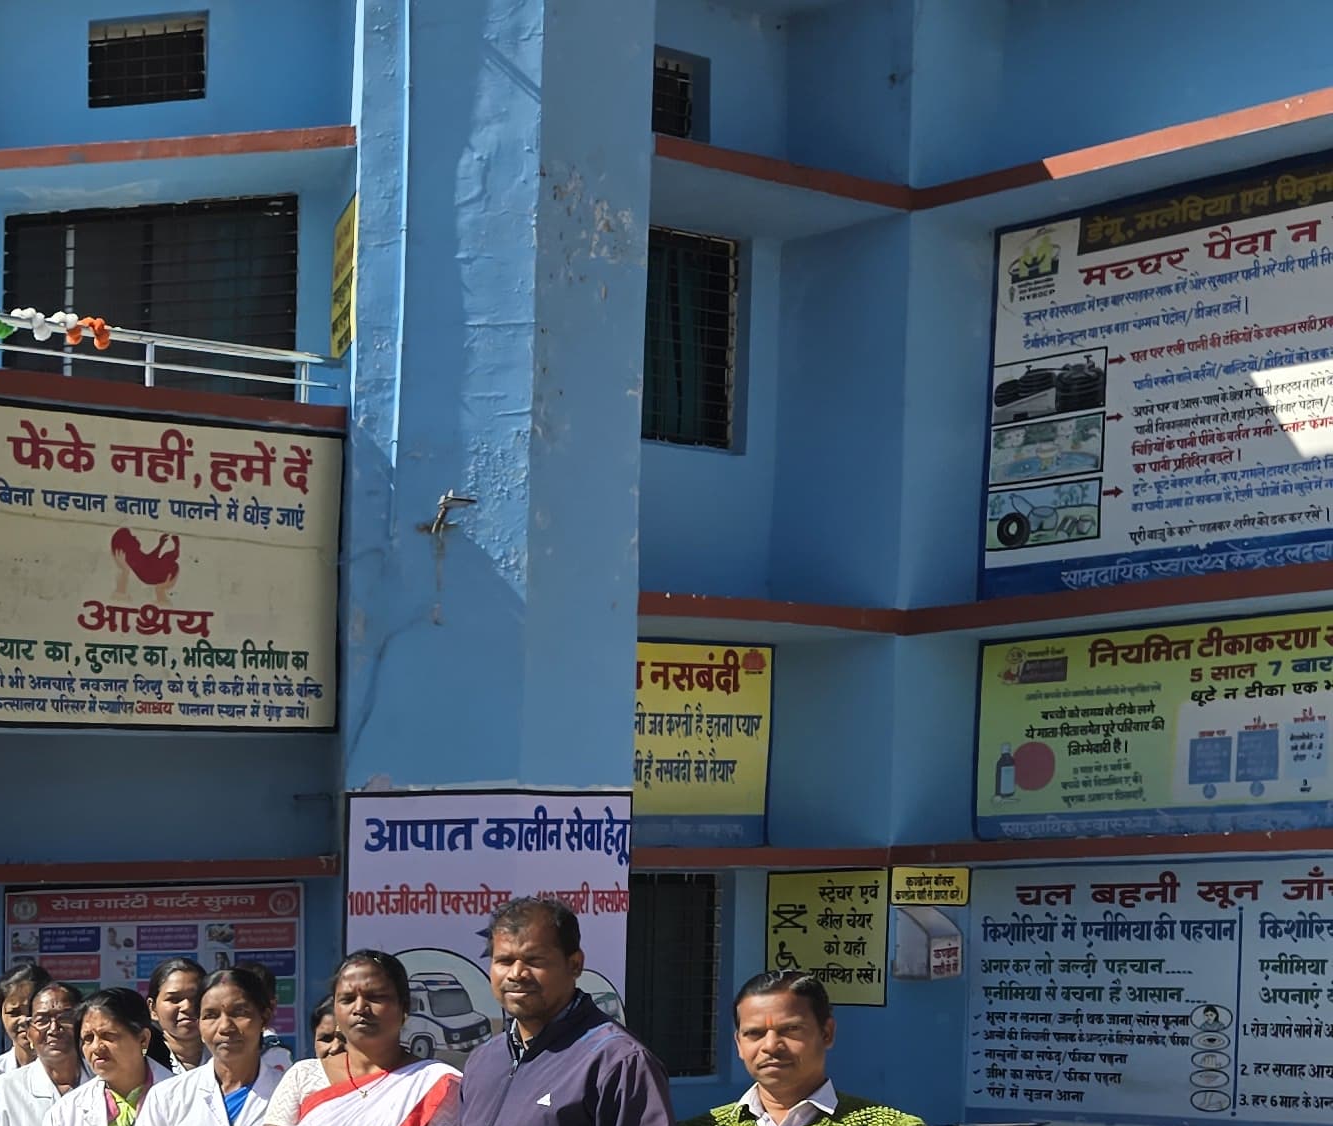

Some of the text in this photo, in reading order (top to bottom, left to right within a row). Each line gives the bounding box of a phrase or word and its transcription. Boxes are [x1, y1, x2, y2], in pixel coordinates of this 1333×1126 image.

[1203, 226, 1278, 260] पैदा
[1286, 220, 1321, 243] न
[7, 419, 96, 473] फेंके
[210, 441, 276, 492] हमें
[283, 445, 313, 495] दें
[41, 489, 107, 513] पहचान
[114, 493, 159, 519] बताए
[169, 494, 221, 522] पालने
[226, 496, 239, 523] में
[77, 600, 214, 639] आश्रय
[85, 641, 139, 674] दुलार
[182, 638, 236, 670] भविष्य
[241, 639, 289, 671] निर्माण
[292, 648, 309, 671] का
[1089, 626, 1321, 668] नियमित टीकाकरण
[650, 649, 741, 696] नसबंदी
[1190, 668, 1203, 683] 5
[1211, 663, 1257, 682] साल
[1268, 660, 1282, 676] 7
[1244, 680, 1286, 699] टीका
[1292, 681, 1318, 695] एक
[364, 817, 480, 853] आपात
[482, 804, 563, 852] कालीन
[565, 807, 604, 853] सेवा
[348, 891, 375, 916] 100
[376, 883, 438, 915] संजीवनी
[858, 880, 880, 904] एवं
[1015, 865, 1333, 909] चल बहनी खून जाँ
[823, 935, 841, 956] को
[981, 910, 1237, 949] किशोरियों में एनीमिया की पहचान
[1258, 952, 1328, 981] एनीमिया
[1045, 978, 1058, 1001] से
[1108, 978, 1122, 1004] है
